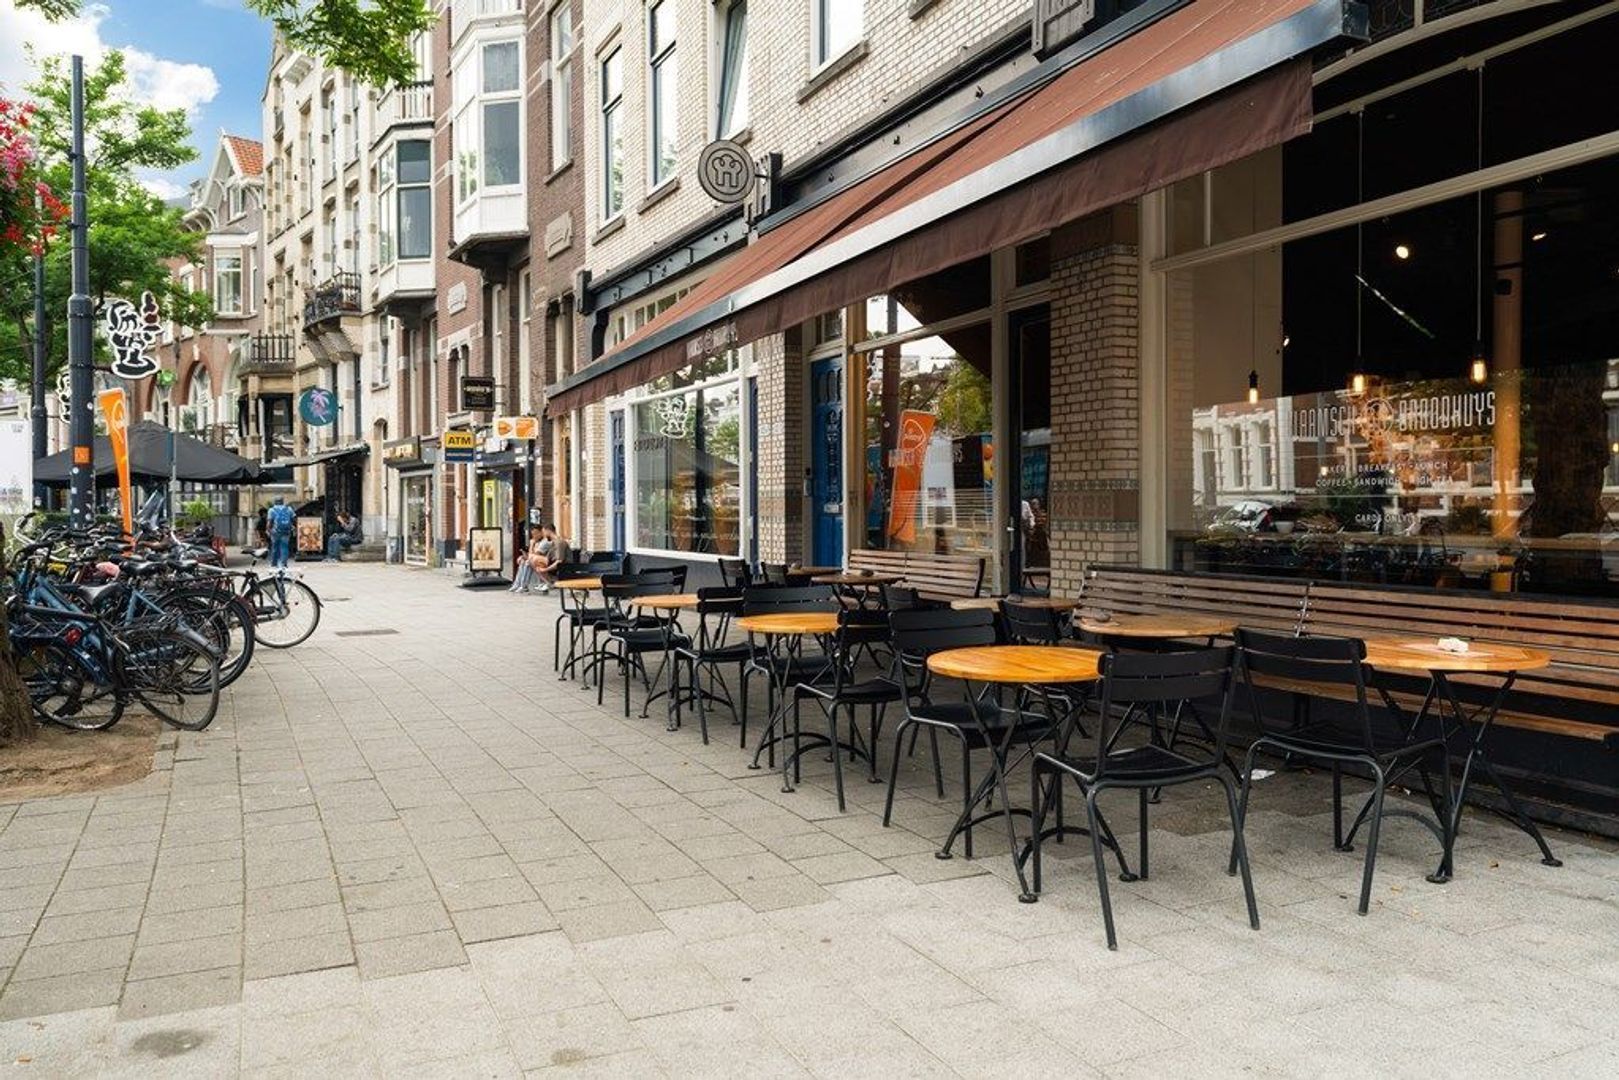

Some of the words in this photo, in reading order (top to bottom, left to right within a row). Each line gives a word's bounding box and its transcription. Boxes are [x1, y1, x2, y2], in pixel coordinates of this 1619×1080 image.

[447, 436, 471, 445] ATM
[1315, 478, 1347, 487] COFFEE
[1354, 476, 1400, 487] SANDWICH
